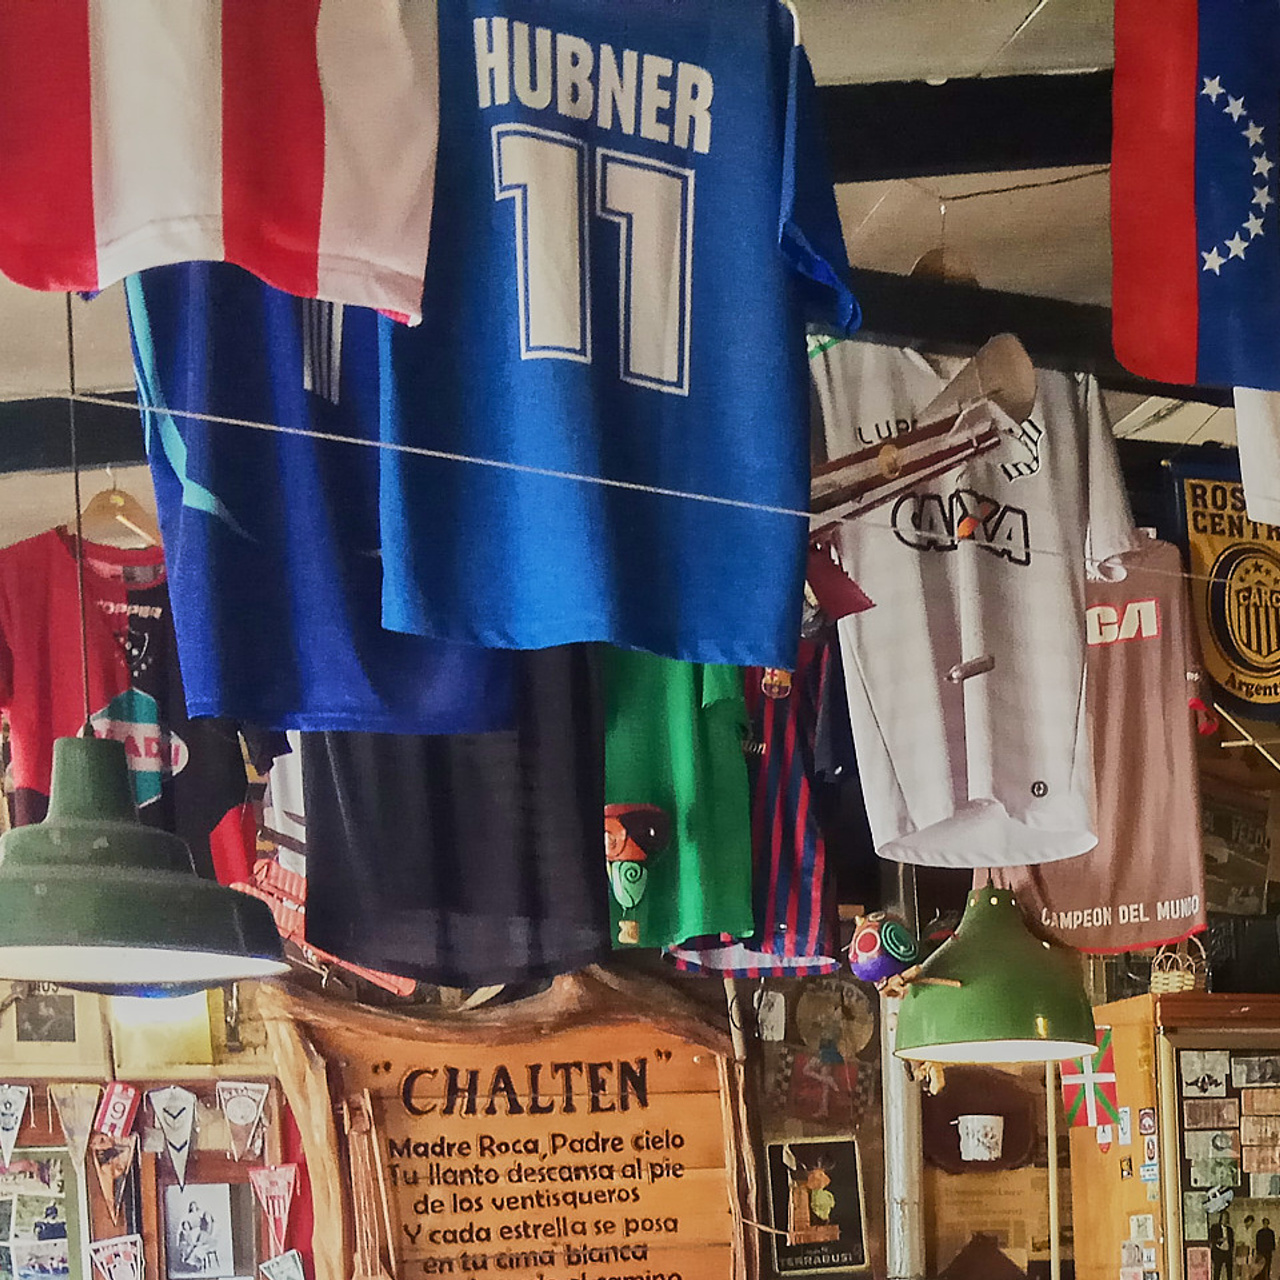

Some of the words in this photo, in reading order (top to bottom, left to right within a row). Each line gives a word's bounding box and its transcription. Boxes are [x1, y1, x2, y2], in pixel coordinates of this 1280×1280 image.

[473, 16, 714, 154] HUBNER
[490, 122, 695, 398] 11
[856, 418, 918, 445] LUP
[1040, 906, 1113, 930] CAMPEON
[1118, 902, 1150, 924] DEL
[389, 1135, 472, 1159] Madre
[479, 1134, 549, 1161] Roca,
[551, 1131, 624, 1155] Padre
[632, 1129, 685, 1152] cielo
[389, 1163, 419, 1187] Tu
[429, 1163, 500, 1187] llanto
[507, 1159, 615, 1185] descansa
[621, 1157, 643, 1181] al
[649, 1157, 685, 1185] pie
[413, 1191, 445, 1216] de
[452, 1190, 483, 1214] los
[491, 1186, 641, 1214] ventisqueros
[402, 1222, 423, 1245] Y
[428, 1220, 492, 1245] cada
[498, 1216, 588, 1241] estrella
[593, 1217, 616, 1236] se
[622, 1215, 680, 1239] posa
[423, 1256, 452, 1275] en
[460, 1250, 488, 1272] tu
[495, 1246, 557, 1270] cima
[566, 1241, 649, 1267] blanca
